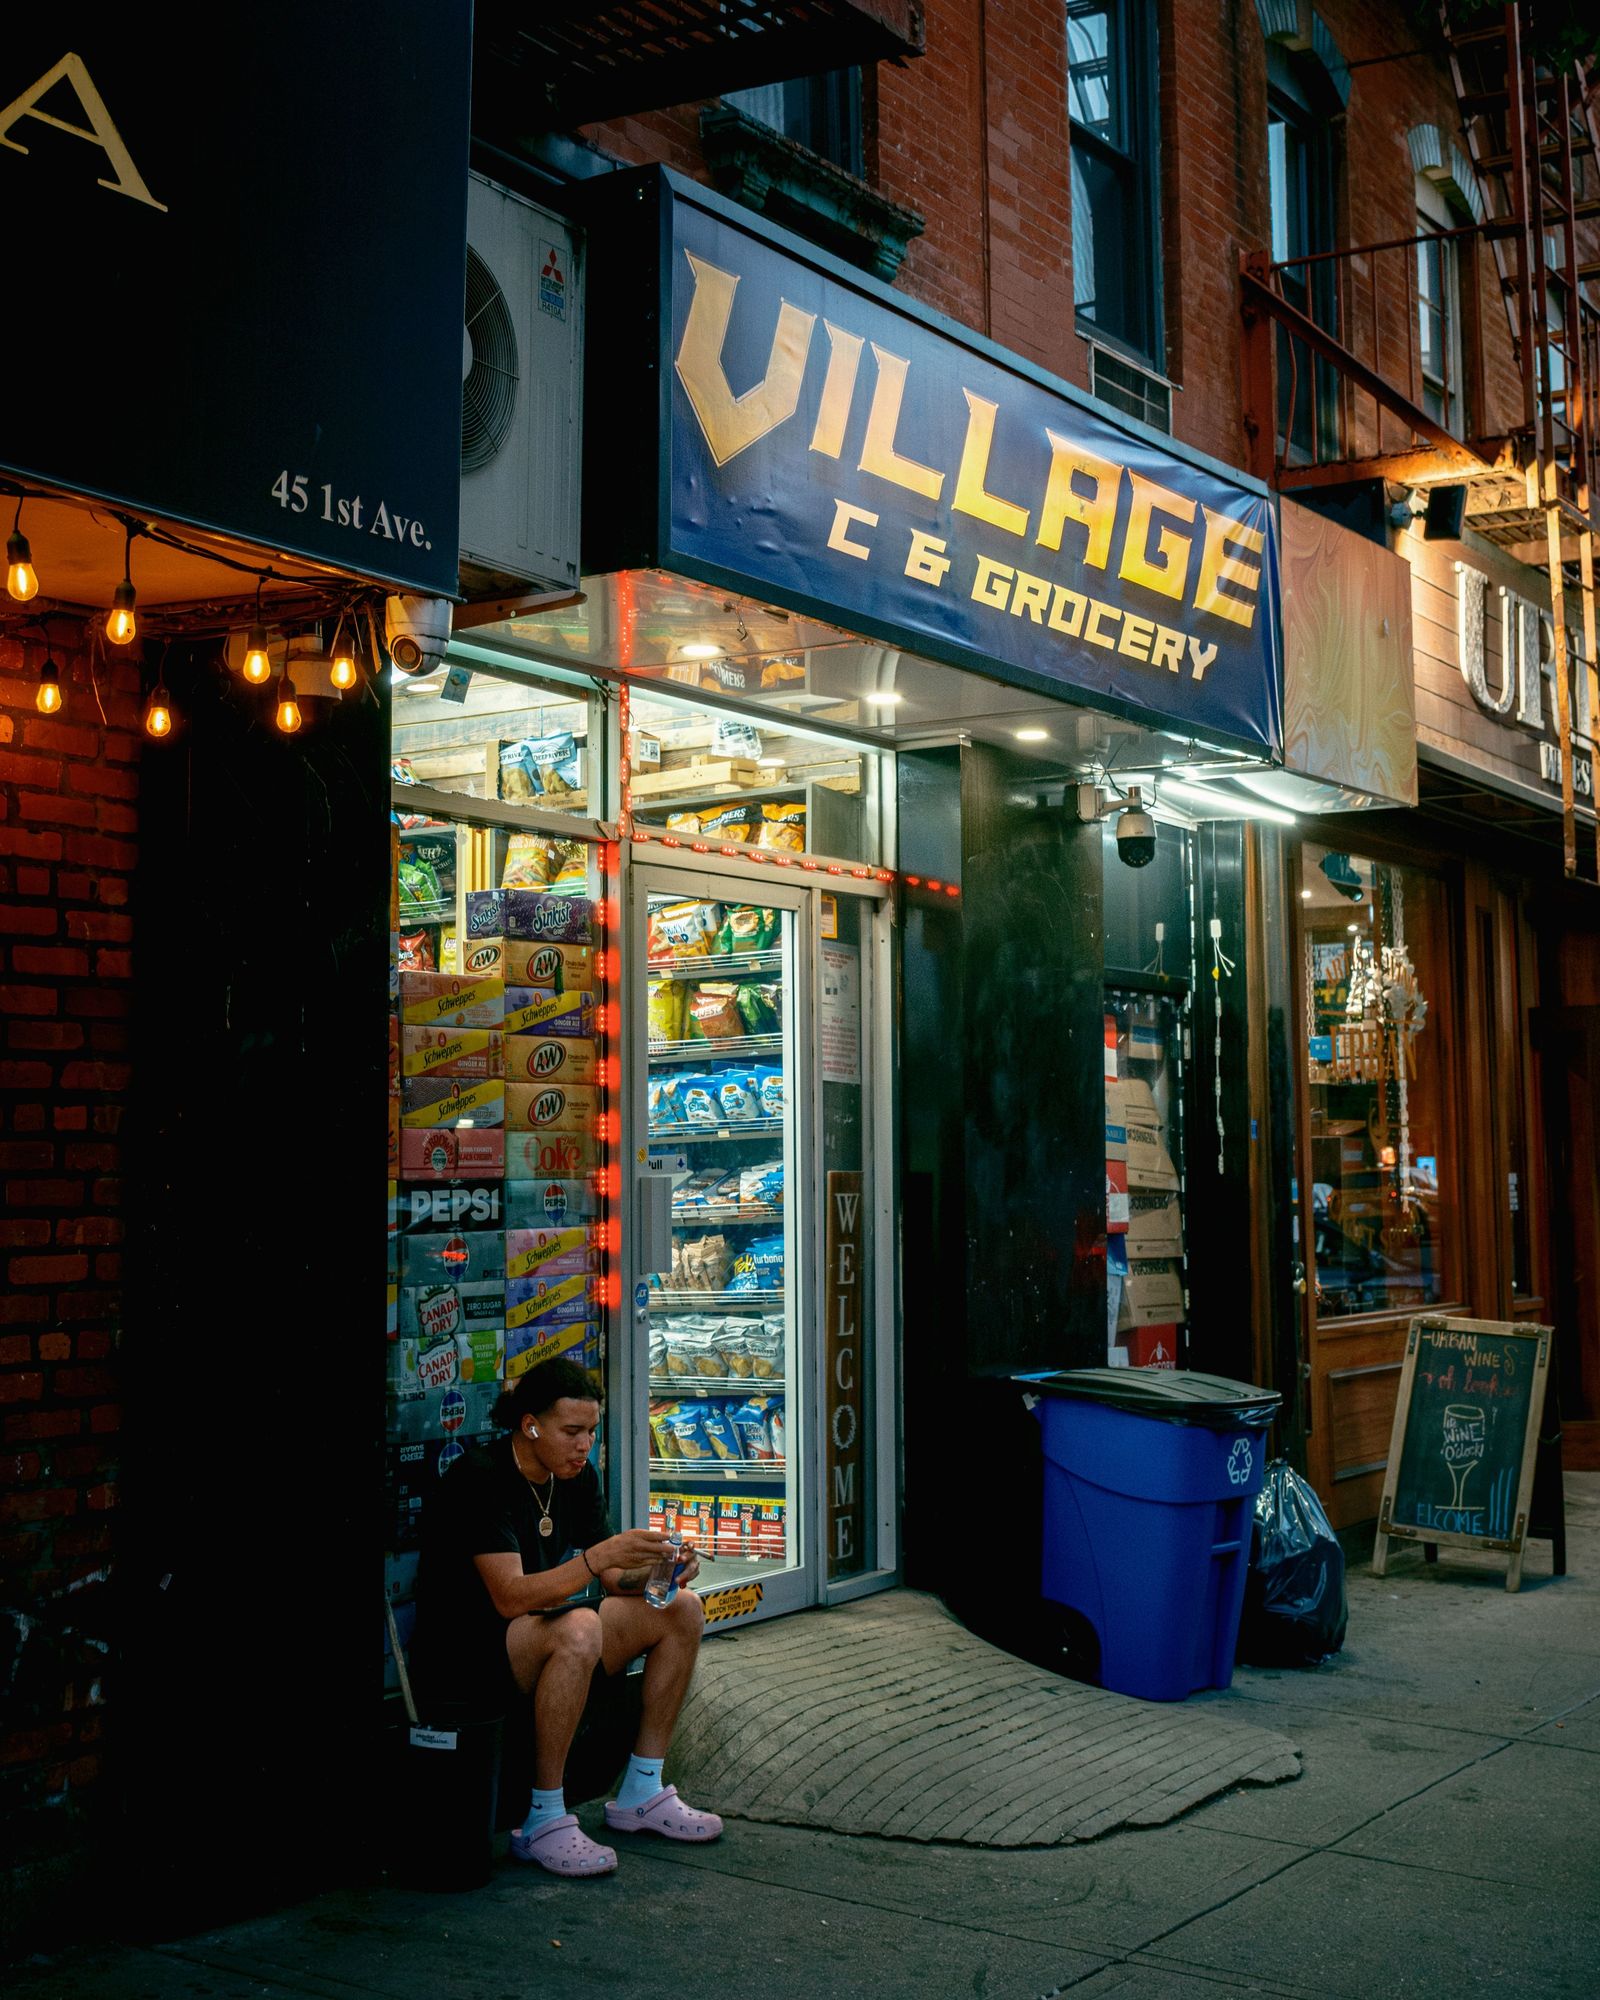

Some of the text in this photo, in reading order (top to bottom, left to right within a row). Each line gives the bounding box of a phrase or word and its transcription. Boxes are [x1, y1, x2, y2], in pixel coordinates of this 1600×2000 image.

[0, 51, 168, 213] A
[674, 248, 1267, 630] VILLAGE
[271, 470, 432, 551] 45 1st Ave.
[827, 499, 1218, 682] C & GROCERY
[471, 901, 500, 932] Sunkist
[532, 901, 572, 934] Sunkist
[437, 989, 476, 1016] Schweppes
[521, 1001, 558, 1026] Schweppes
[423, 1041, 463, 1068] Schweppes
[438, 1092, 477, 1120] Schweppes
[523, 1136, 583, 1171] Coke
[411, 1188, 499, 1222] PEPSI
[545, 1199, 566, 1208] PEPSI
[525, 1241, 561, 1270] Schweppes
[420, 1297, 459, 1325] CANADA
[525, 1288, 561, 1319] Schweppes
[431, 1316, 453, 1335] DRY
[418, 1350, 458, 1379] CANADA
[525, 1338, 560, 1370] Schweppes
[431, 1368, 452, 1387] DRY
[831, 1193, 860, 1561] WELCOME
[441, 1407, 464, 1416] PEPSI
[683, 1508, 697, 1516] KIND
[721, 1509, 738, 1518] KIND
[761, 1511, 779, 1520] KIND
[708, 1599, 754, 1616] WATCH YOUR STEP
